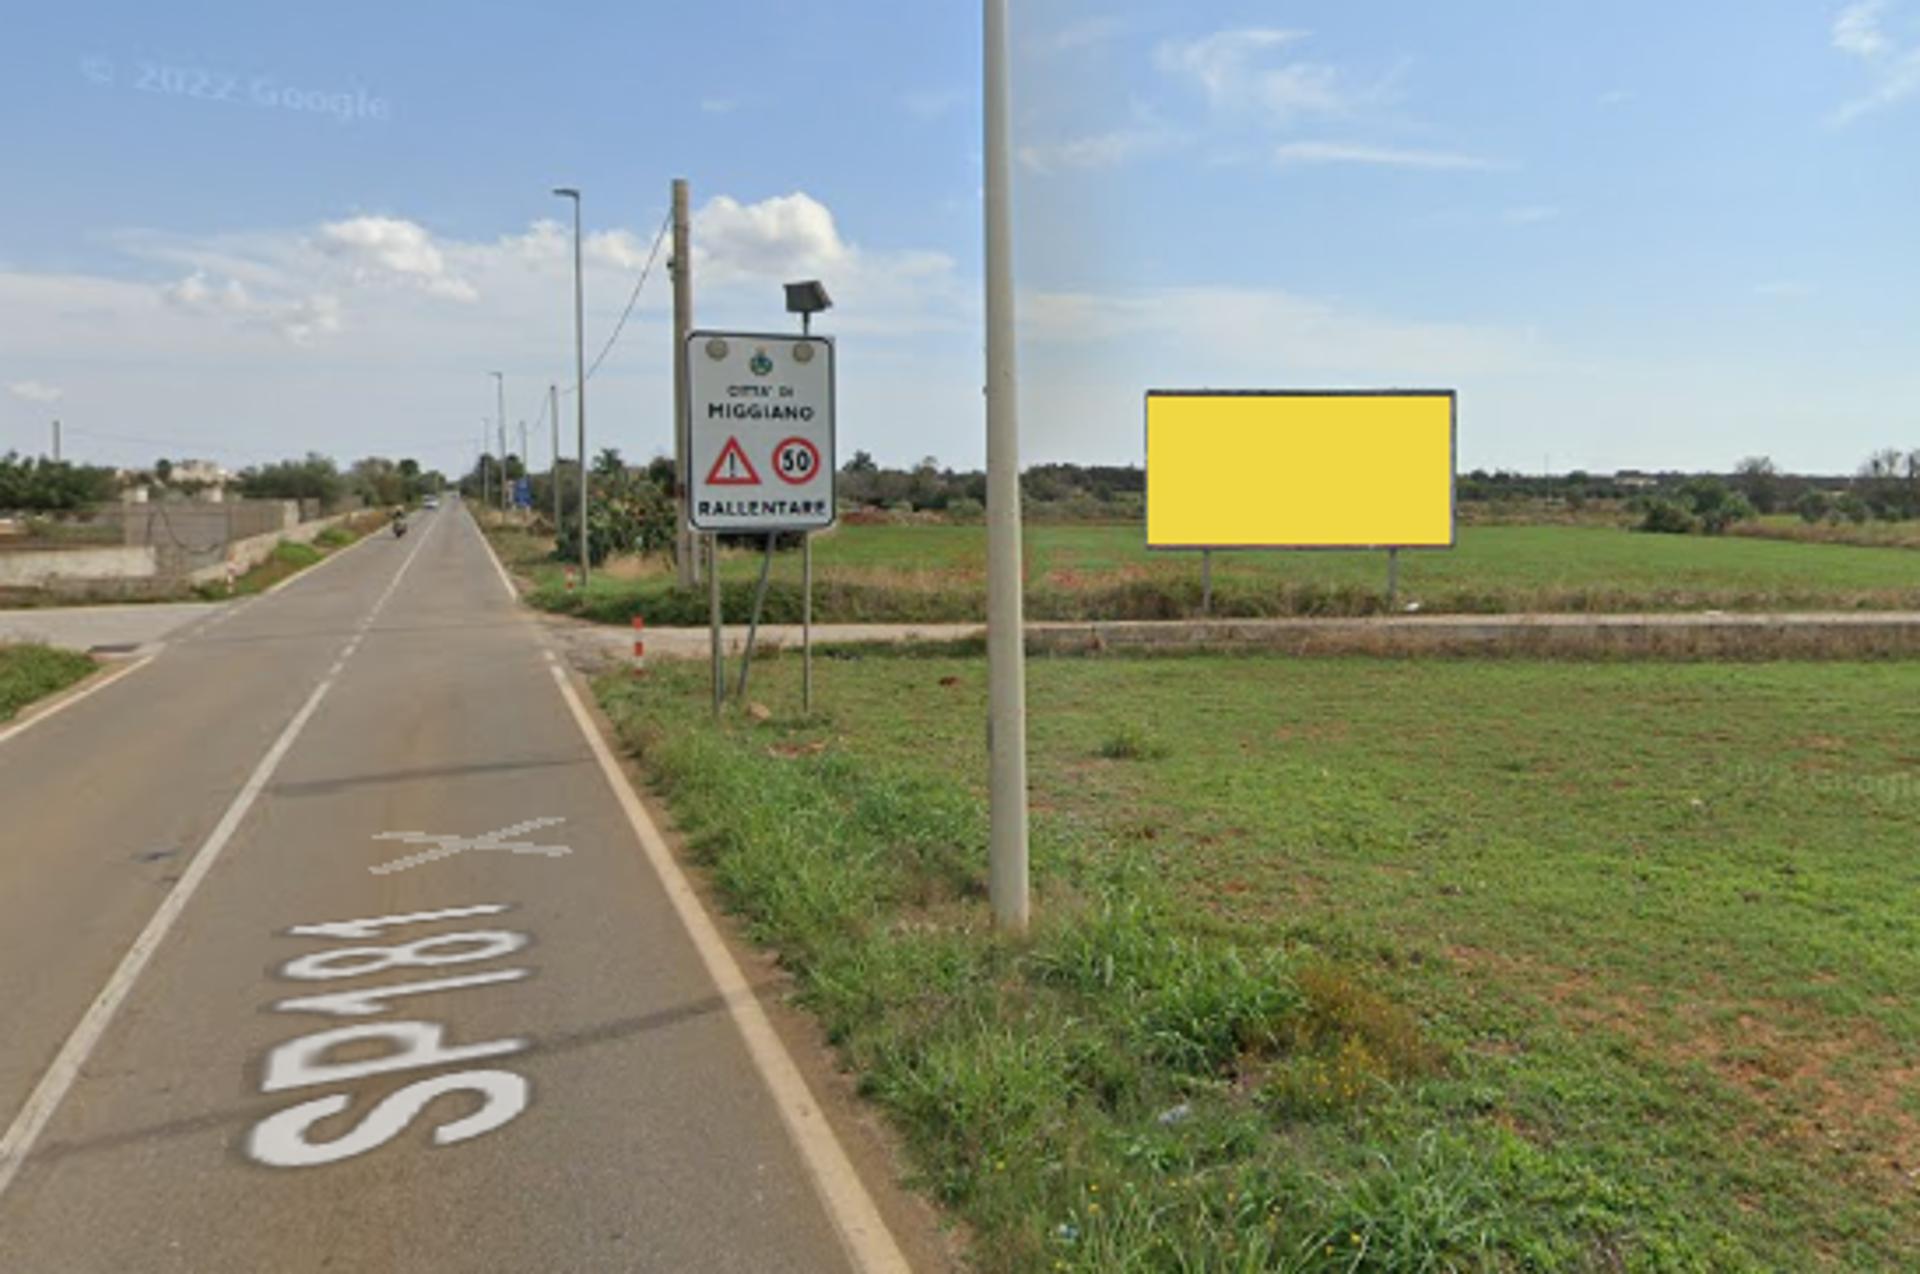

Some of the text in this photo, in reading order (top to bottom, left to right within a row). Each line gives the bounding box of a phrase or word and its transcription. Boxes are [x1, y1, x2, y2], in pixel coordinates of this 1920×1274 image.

[708, 403, 814, 421] MIGGIANO
[781, 449, 810, 472] 50
[698, 501, 826, 516] RALLENTARE
